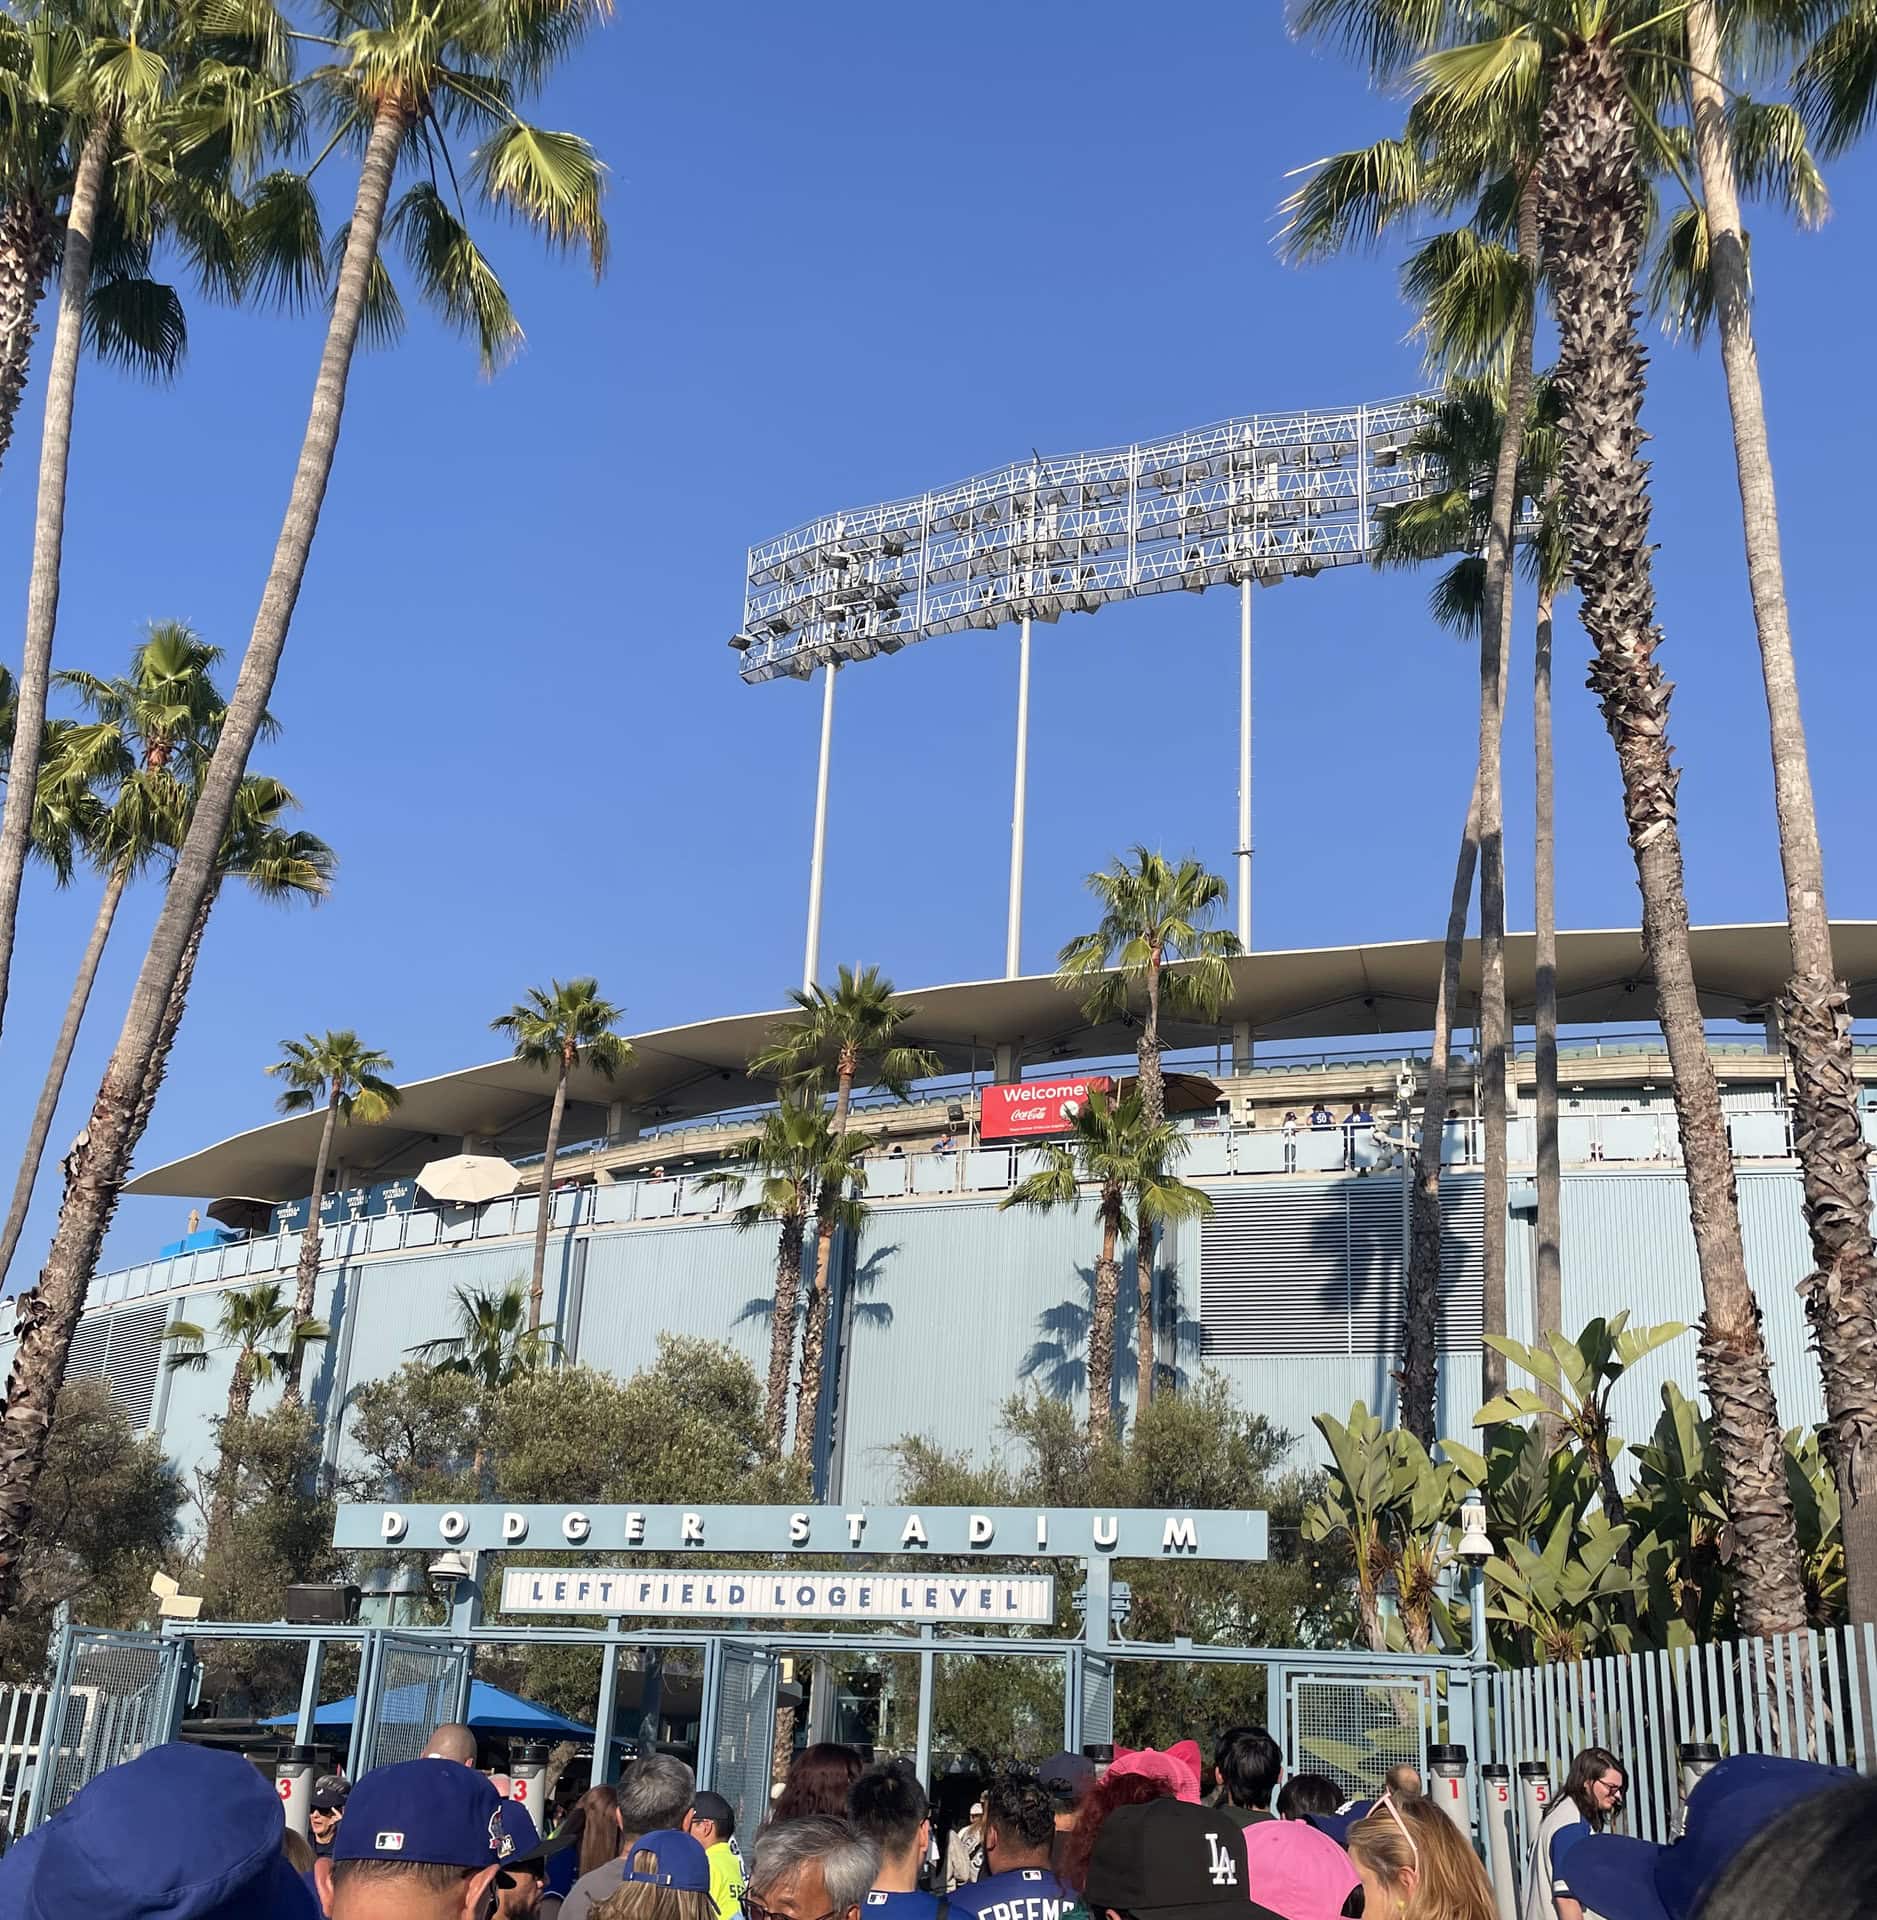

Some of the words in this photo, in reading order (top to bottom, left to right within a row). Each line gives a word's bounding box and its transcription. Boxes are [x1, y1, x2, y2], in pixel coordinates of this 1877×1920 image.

[380, 1511, 705, 1545] DODGER
[788, 1513, 1198, 1552] STADIUM
[532, 1581, 612, 1601] LEFT
[639, 1583, 745, 1605] FIELD
[774, 1585, 871, 1609] LOGE
[901, 1587, 1018, 1611] LEVEL
[279, 1779, 292, 1800] 3
[513, 1780, 527, 1801] 3
[1449, 1779, 1459, 1800] 1
[1498, 1786, 1508, 1802] 5
[1536, 1786, 1547, 1802] 5
[1205, 1833, 1238, 1885] LA
